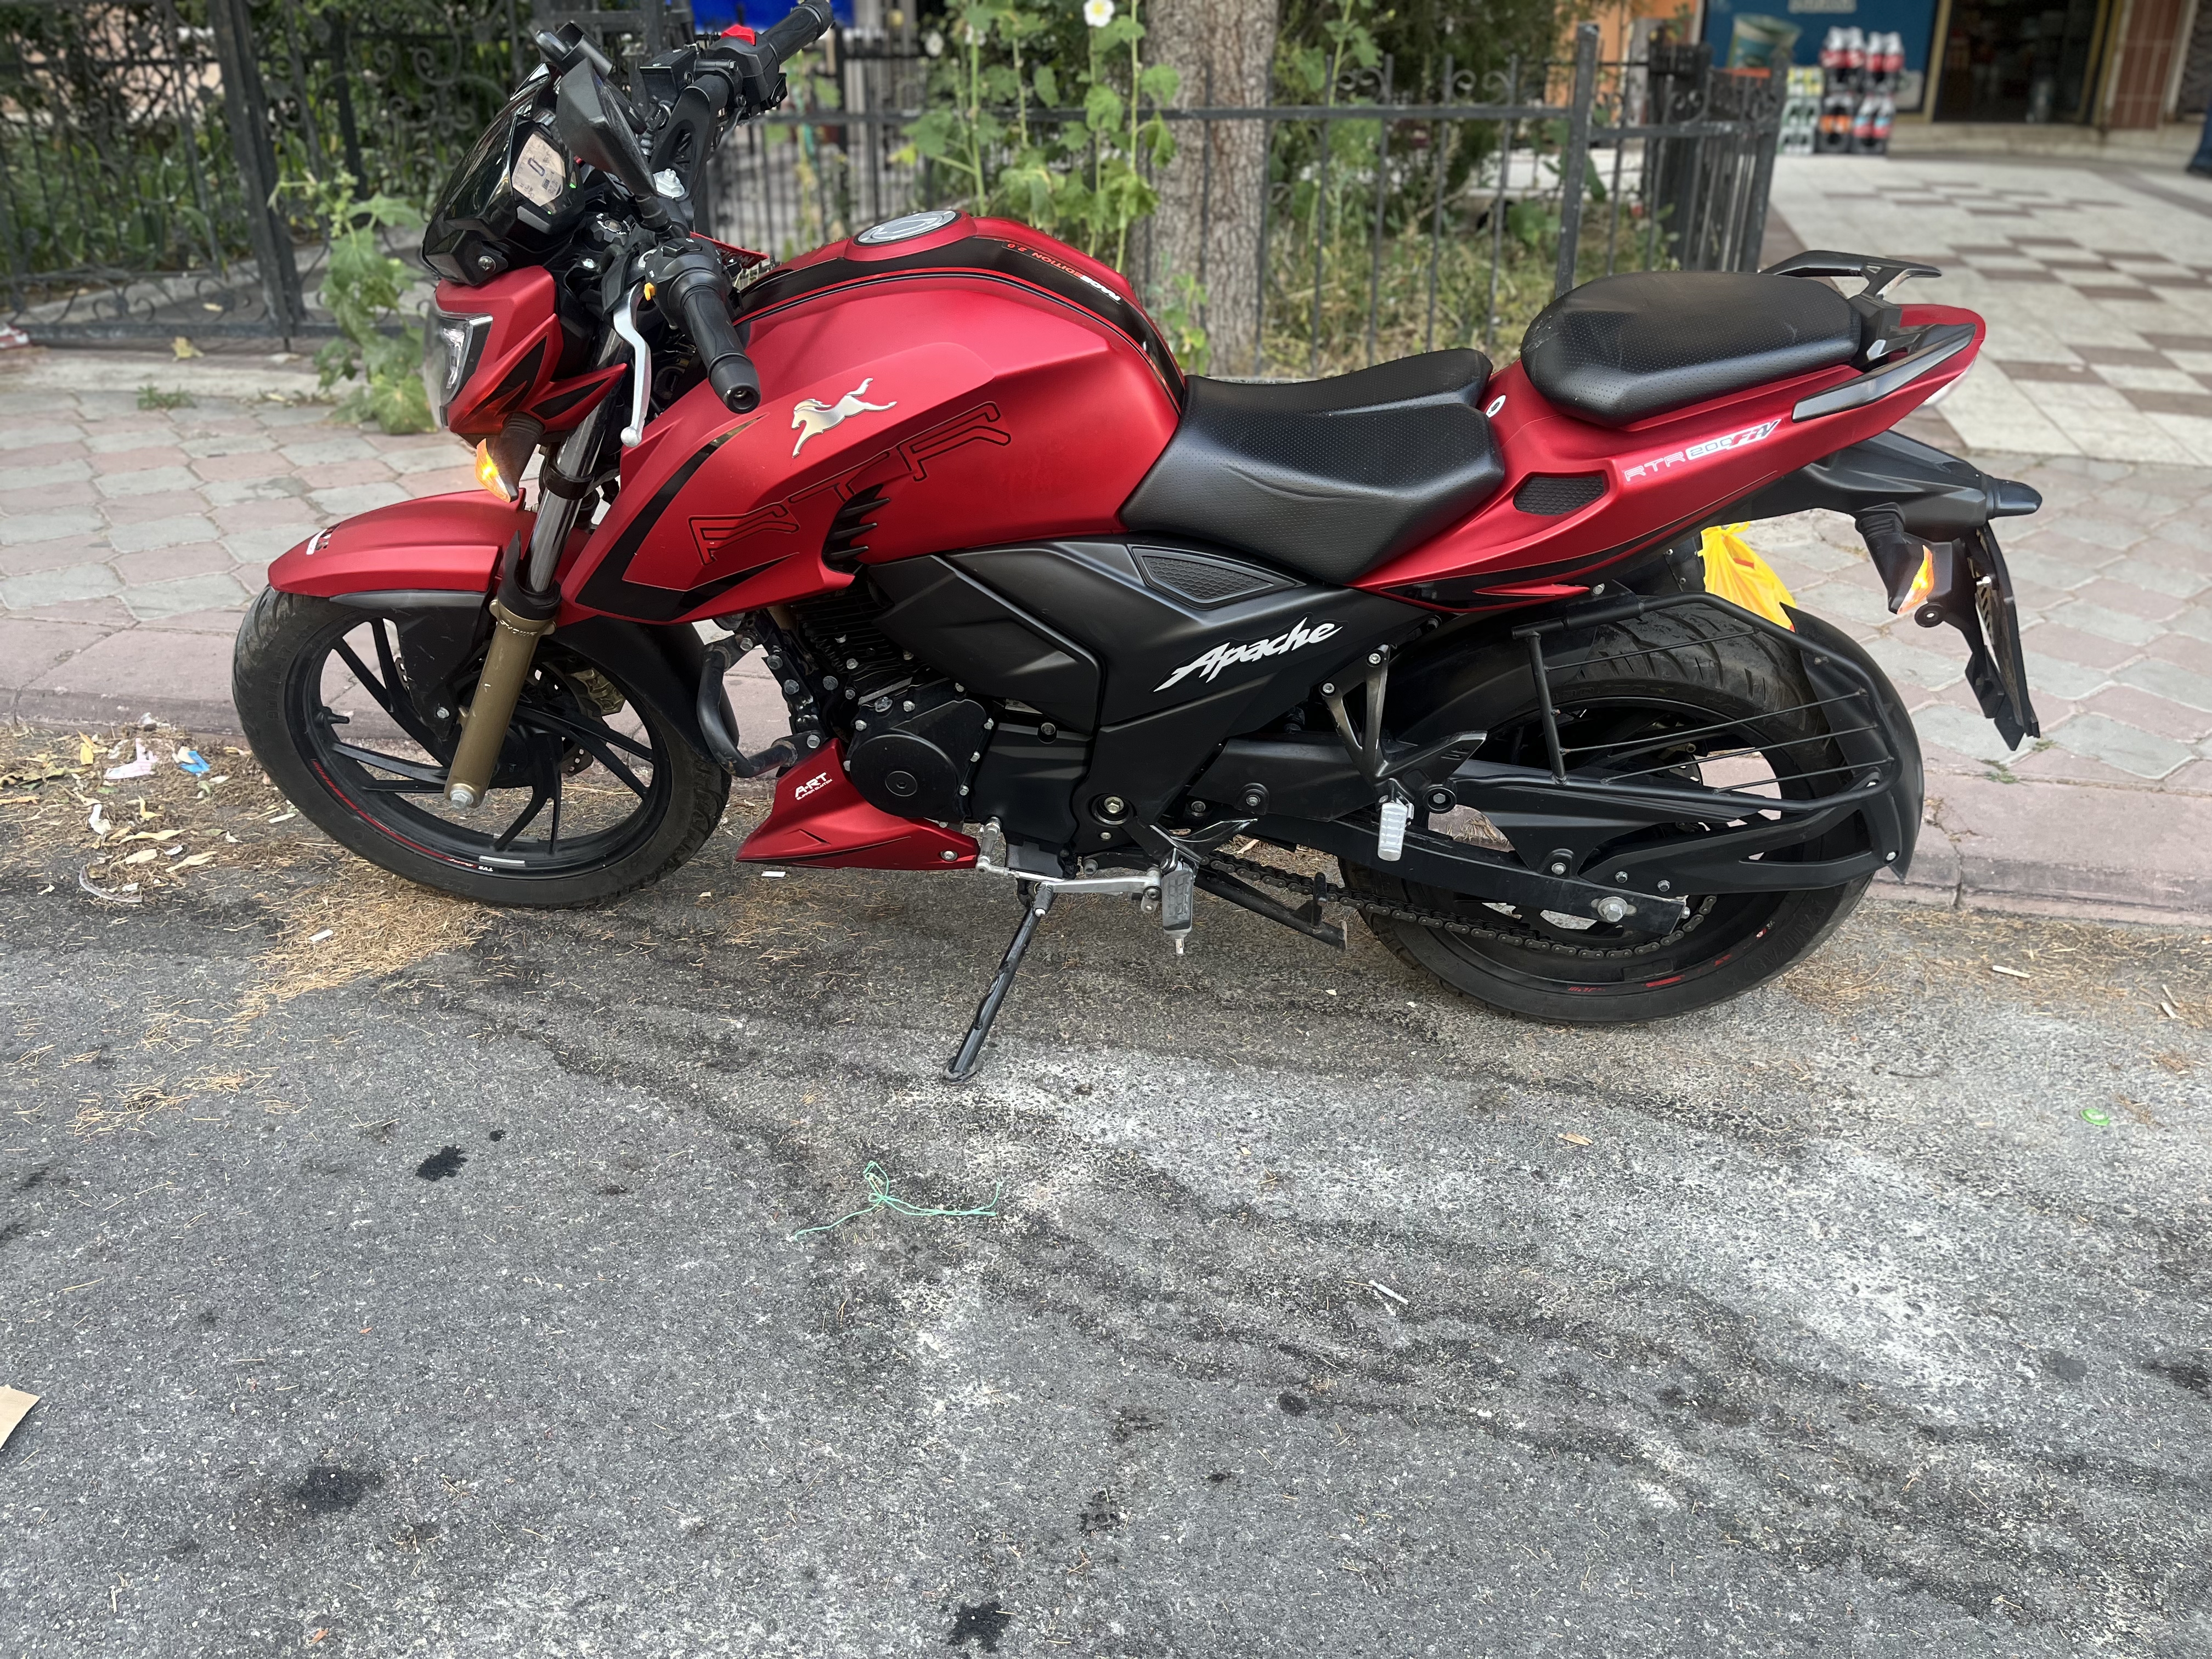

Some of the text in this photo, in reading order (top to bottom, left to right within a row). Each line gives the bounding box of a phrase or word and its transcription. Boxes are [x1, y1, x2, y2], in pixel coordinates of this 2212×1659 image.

[528, 157, 545, 177] 0
[1007, 242, 1028, 252] 2.0
[1031, 251, 1084, 279] EDITION
[1623, 451, 1686, 482] RTR
[1690, 437, 1734, 456] 200
[688, 400, 1011, 566] RTR
[1153, 617, 1344, 692] Apache
